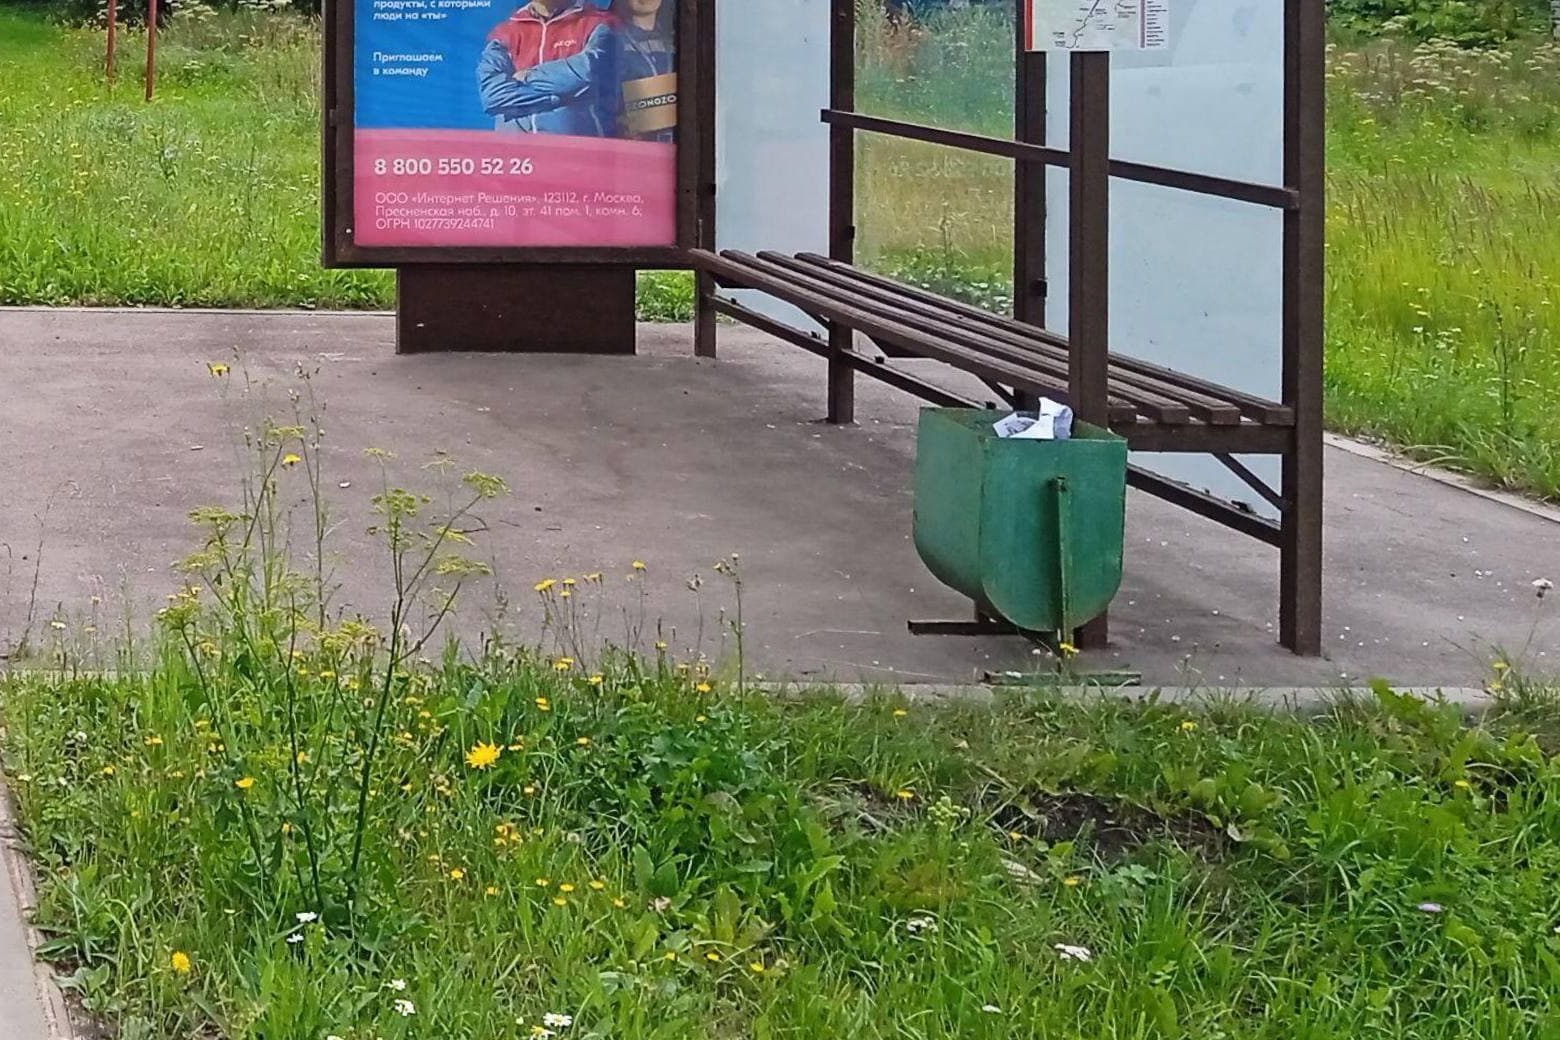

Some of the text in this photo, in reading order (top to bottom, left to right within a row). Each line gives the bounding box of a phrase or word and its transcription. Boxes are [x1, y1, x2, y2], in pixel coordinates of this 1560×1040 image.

[374, 0, 428, 10] продукты,
[438, 0, 491, 10] которыми
[373, 13, 402, 21] люди
[373, 51, 443, 64] Приглашаем
[382, 68, 429, 78] команду
[374, 158, 534, 175] 8 800 550 52 26
[375, 192, 408, 204] ООО
[375, 205, 454, 217] Пресненская
[540, 206, 551, 216] 41
[376, 218, 410, 230] ОГРН
